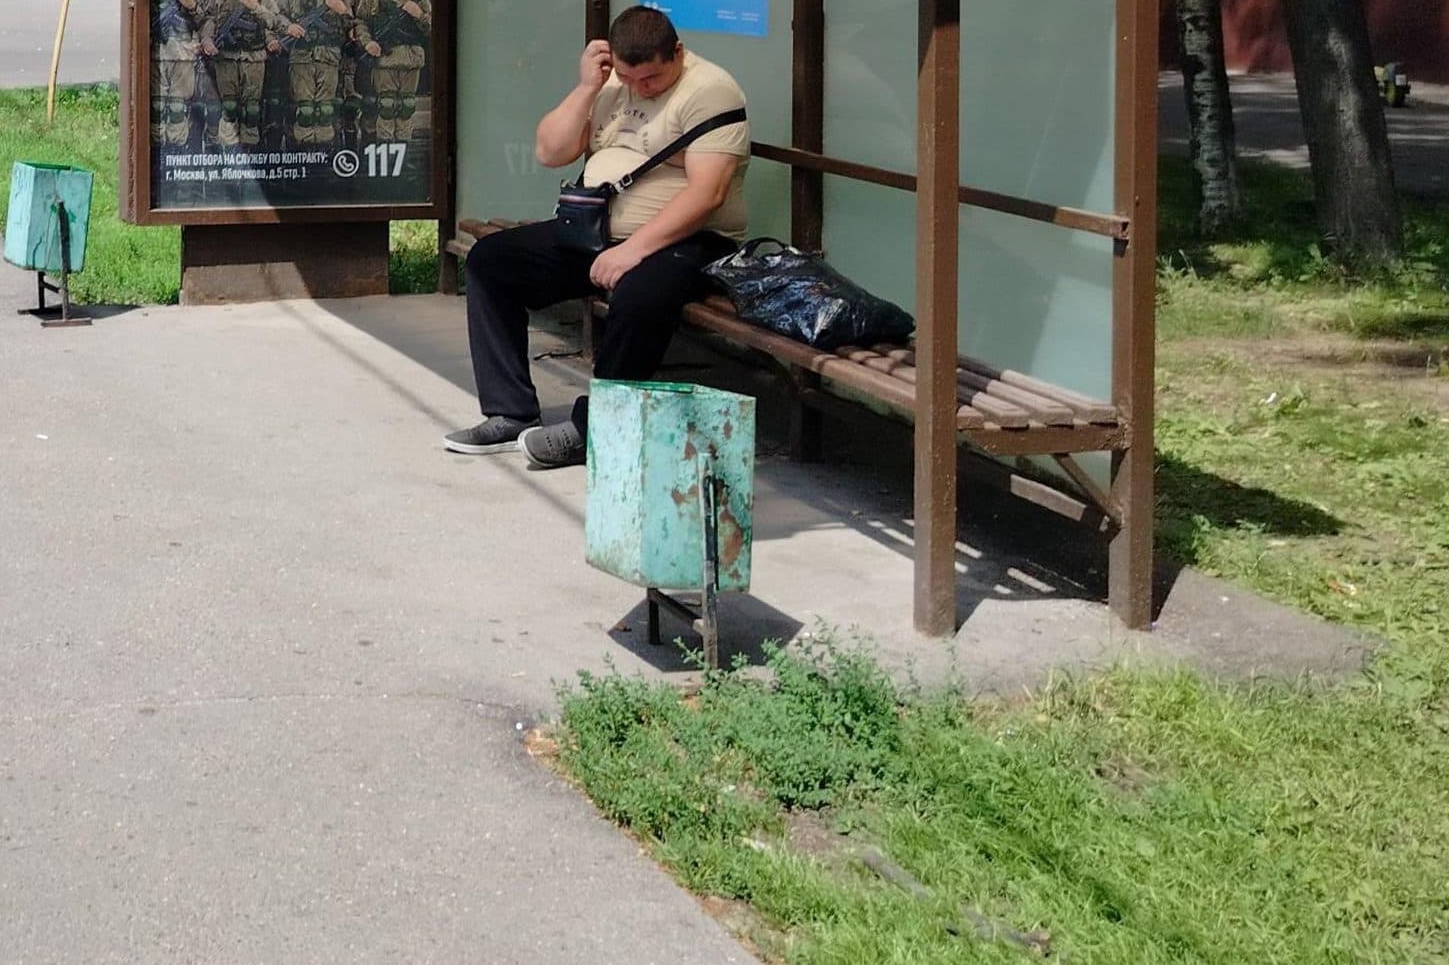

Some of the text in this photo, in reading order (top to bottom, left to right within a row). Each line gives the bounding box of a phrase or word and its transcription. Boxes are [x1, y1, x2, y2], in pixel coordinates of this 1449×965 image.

[165, 152, 328, 167] ПУНКТ ОТБОРА НА СЛУЖБУ ПО КОНТРАКТУ:
[364, 143, 407, 177] 117
[174, 169, 207, 180] Москва,
[209, 171, 220, 181] ул.
[284, 170, 299, 179] стр.
